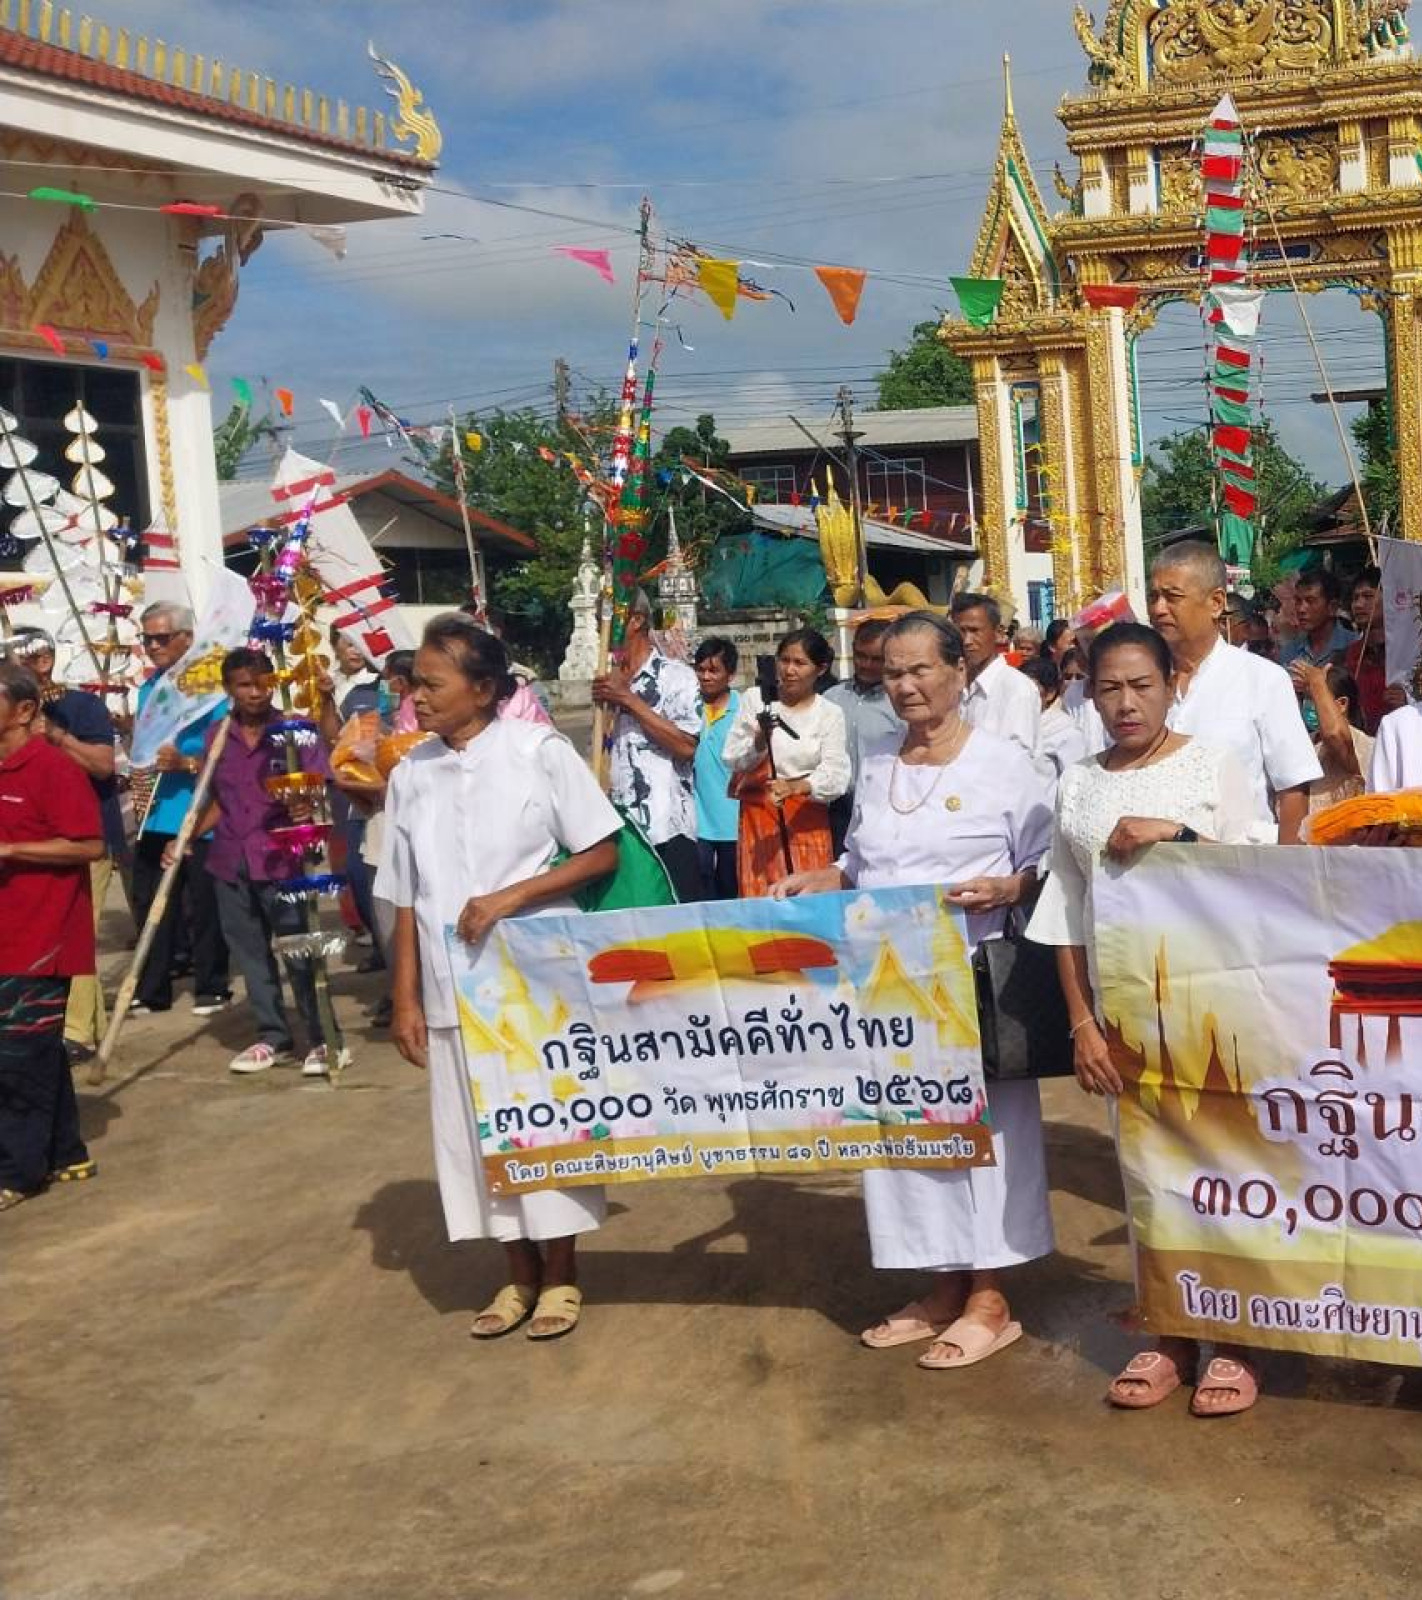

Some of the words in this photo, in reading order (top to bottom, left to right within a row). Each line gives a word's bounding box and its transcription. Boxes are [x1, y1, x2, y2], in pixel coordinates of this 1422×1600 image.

[541, 993, 914, 1081] กฐินสามัคคีทั่วไทย
[494, 1093, 653, 1133] ๓๐,๐๐๐
[662, 1086, 697, 1115] วัด
[703, 1079, 845, 1123] พุทธศักราช
[855, 1074, 973, 1106] ๒๕๖๘
[507, 1162, 545, 1180] โดย
[554, 1144, 693, 1173] คณะศิษยานุศิษย์
[700, 1146, 780, 1171] บูชาธรรม
[816, 1138, 830, 1158] ปี
[837, 1134, 974, 1158] หลวงพ่อธัมมชโย
[1179, 1274, 1237, 1320] โดย
